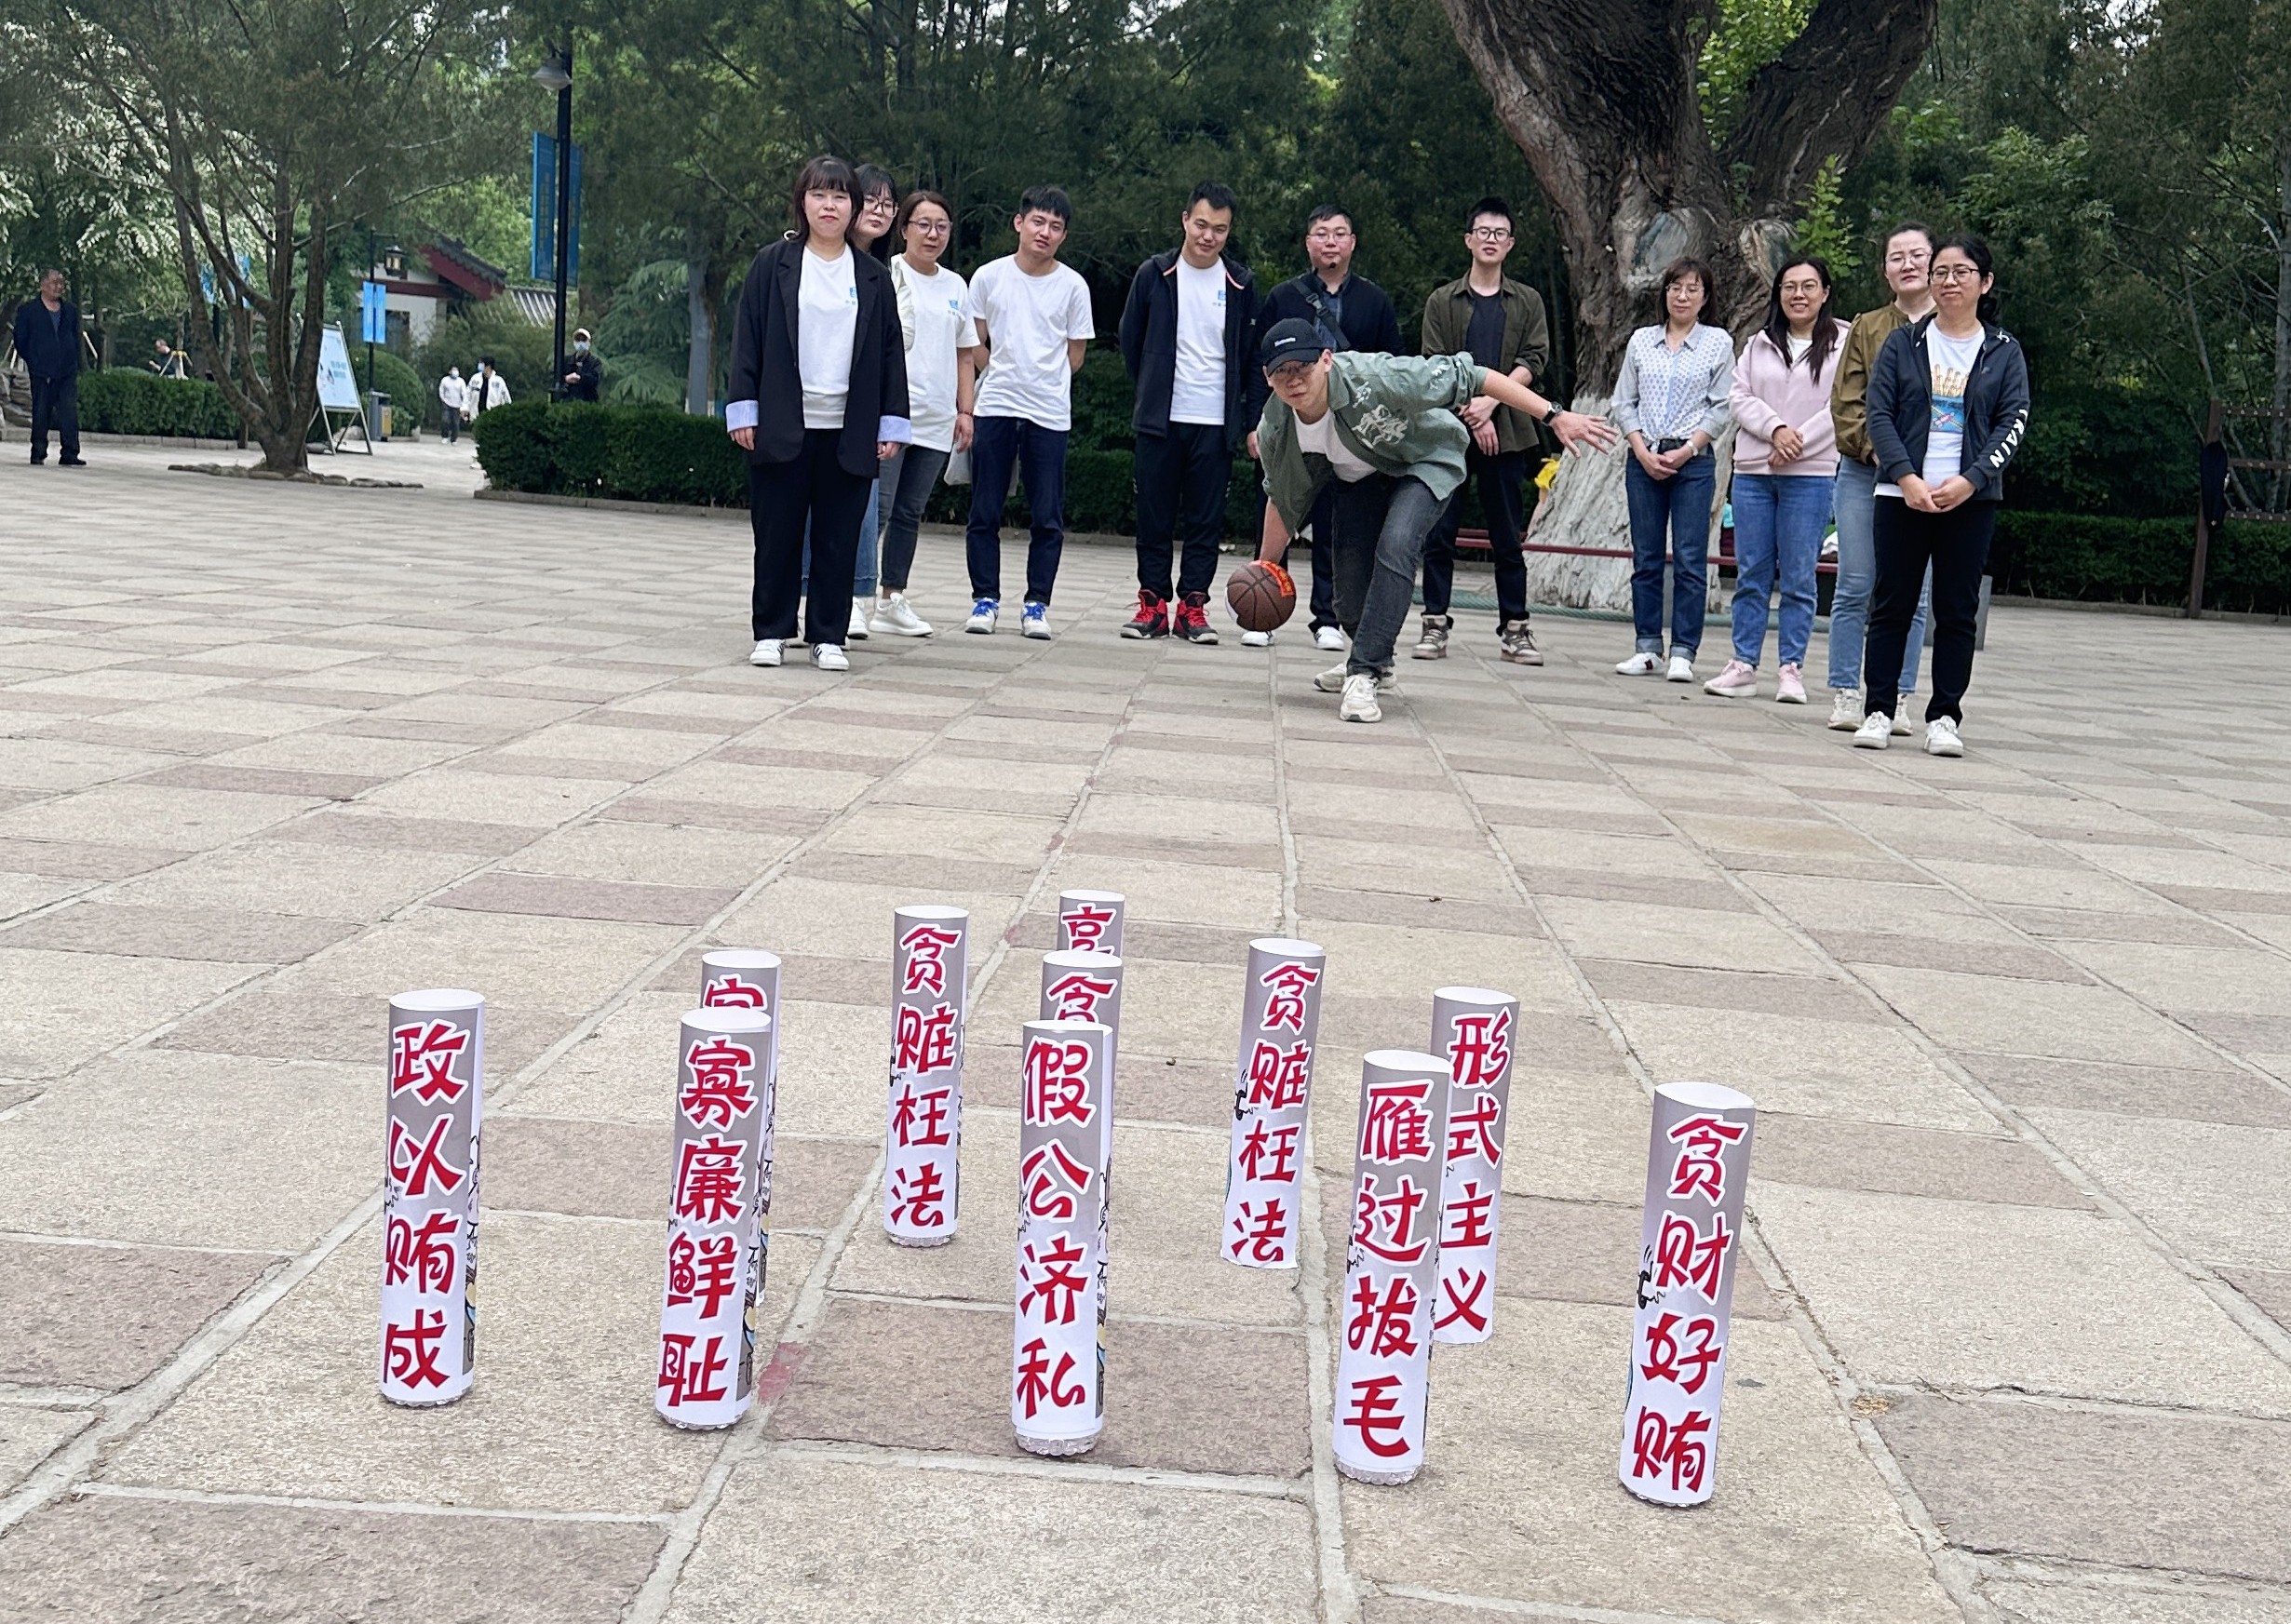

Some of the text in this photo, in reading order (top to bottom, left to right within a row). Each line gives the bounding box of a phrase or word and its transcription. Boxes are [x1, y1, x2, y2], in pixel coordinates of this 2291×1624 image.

[384, 1021, 469, 1389] 政以贿成
[658, 1040, 755, 1406] 寡廉鲜耻
[891, 927, 959, 1226] 贪赃枉法
[1017, 1038, 1094, 1418] 假公济私
[1232, 965, 1319, 1261] 贪赃枉法
[1435, 1011, 1510, 1332] 形式主义
[1343, 1082, 1431, 1457] 雁过拔毛
[1633, 1119, 1748, 1492] 贪财好贿
